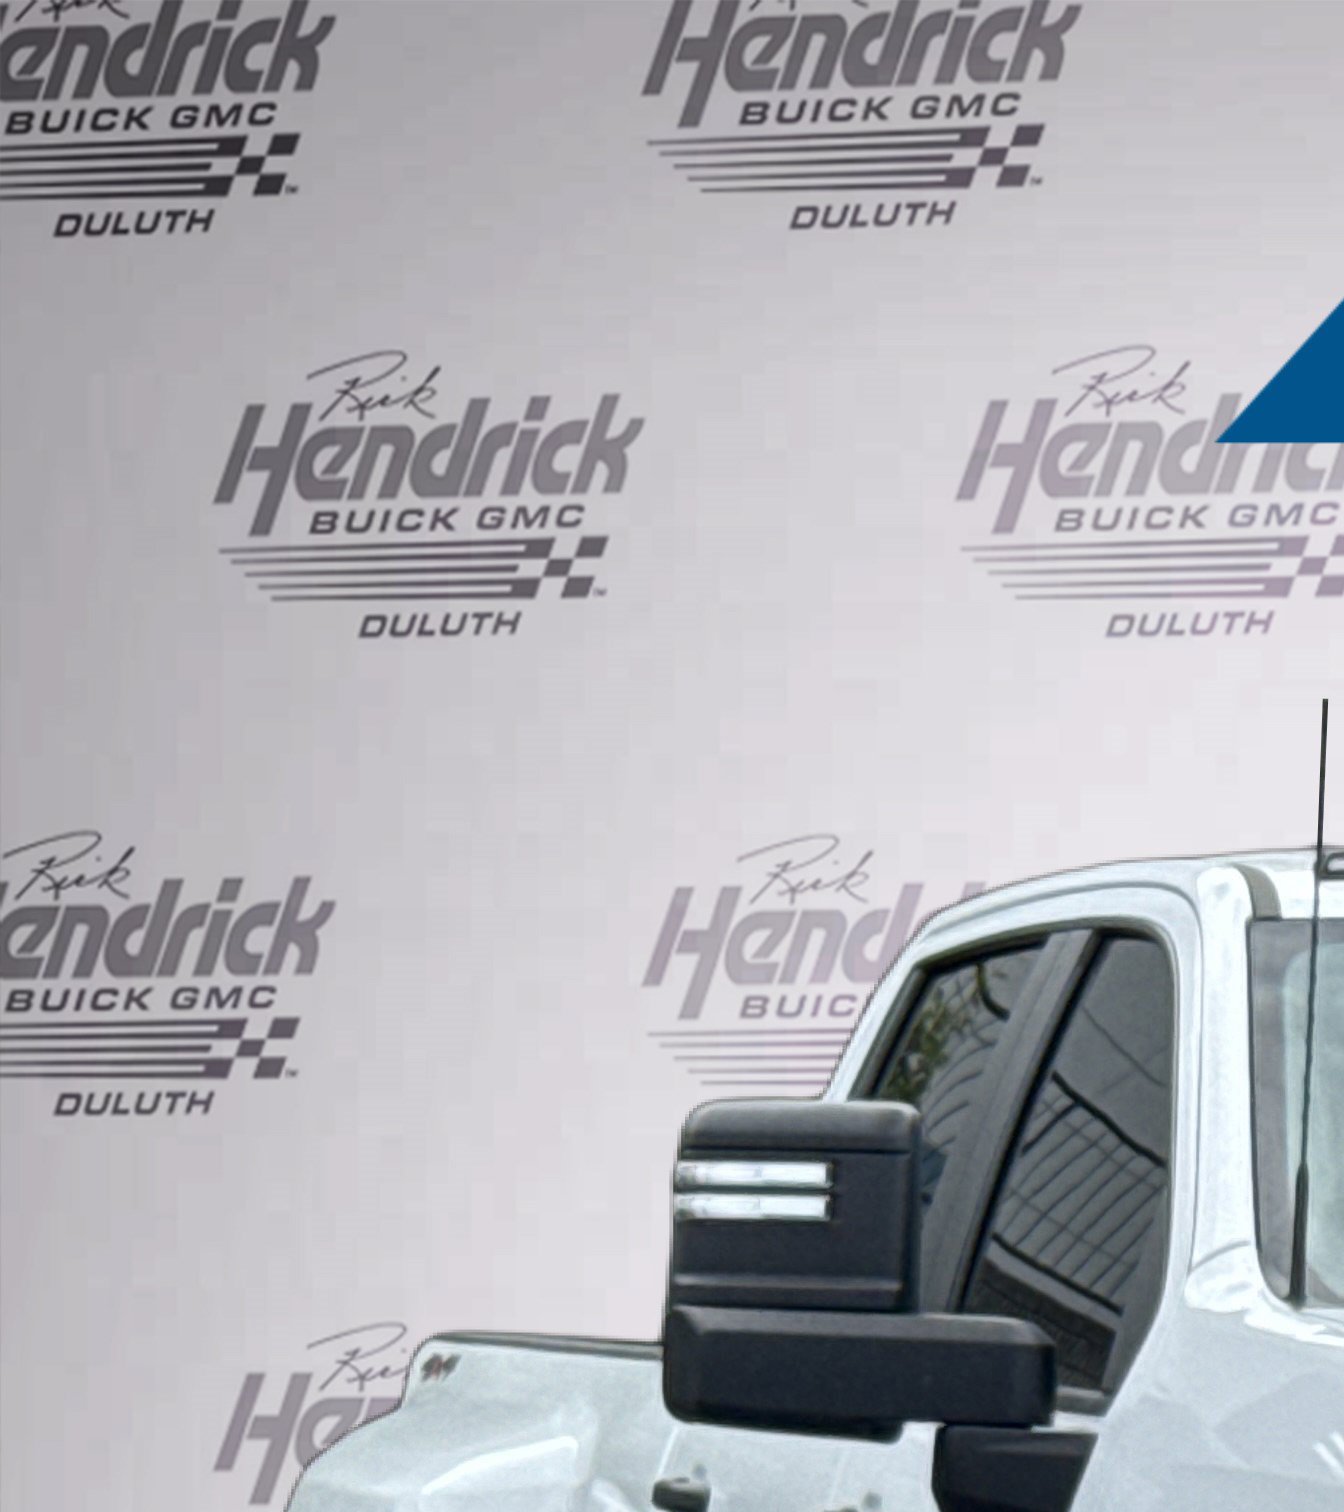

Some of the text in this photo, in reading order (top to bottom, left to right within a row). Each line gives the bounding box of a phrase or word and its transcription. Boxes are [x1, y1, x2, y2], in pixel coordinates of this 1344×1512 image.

[0, 0, 335, 101] endrick
[641, 0, 1082, 128] Hendrick
[4, 102, 278, 135] BUICK GMC
[739, 92, 1021, 126] BUICK GMC
[53, 208, 215, 238] DULUTH
[789, 200, 957, 230] DULUTH
[212, 393, 646, 537] Hendrick
[308, 503, 586, 535] BUICK GMC
[1054, 501, 1341, 533] BUICK GMC
[357, 610, 523, 639] DULUTH
[1104, 609, 1275, 638] DULUTH
[0, 875, 336, 981] endrick
[641, 882, 985, 1020] Hend
[4, 984, 278, 1013] BUICK GMC
[738, 993, 858, 1019] BUIC
[53, 1090, 216, 1117] DULUTH
